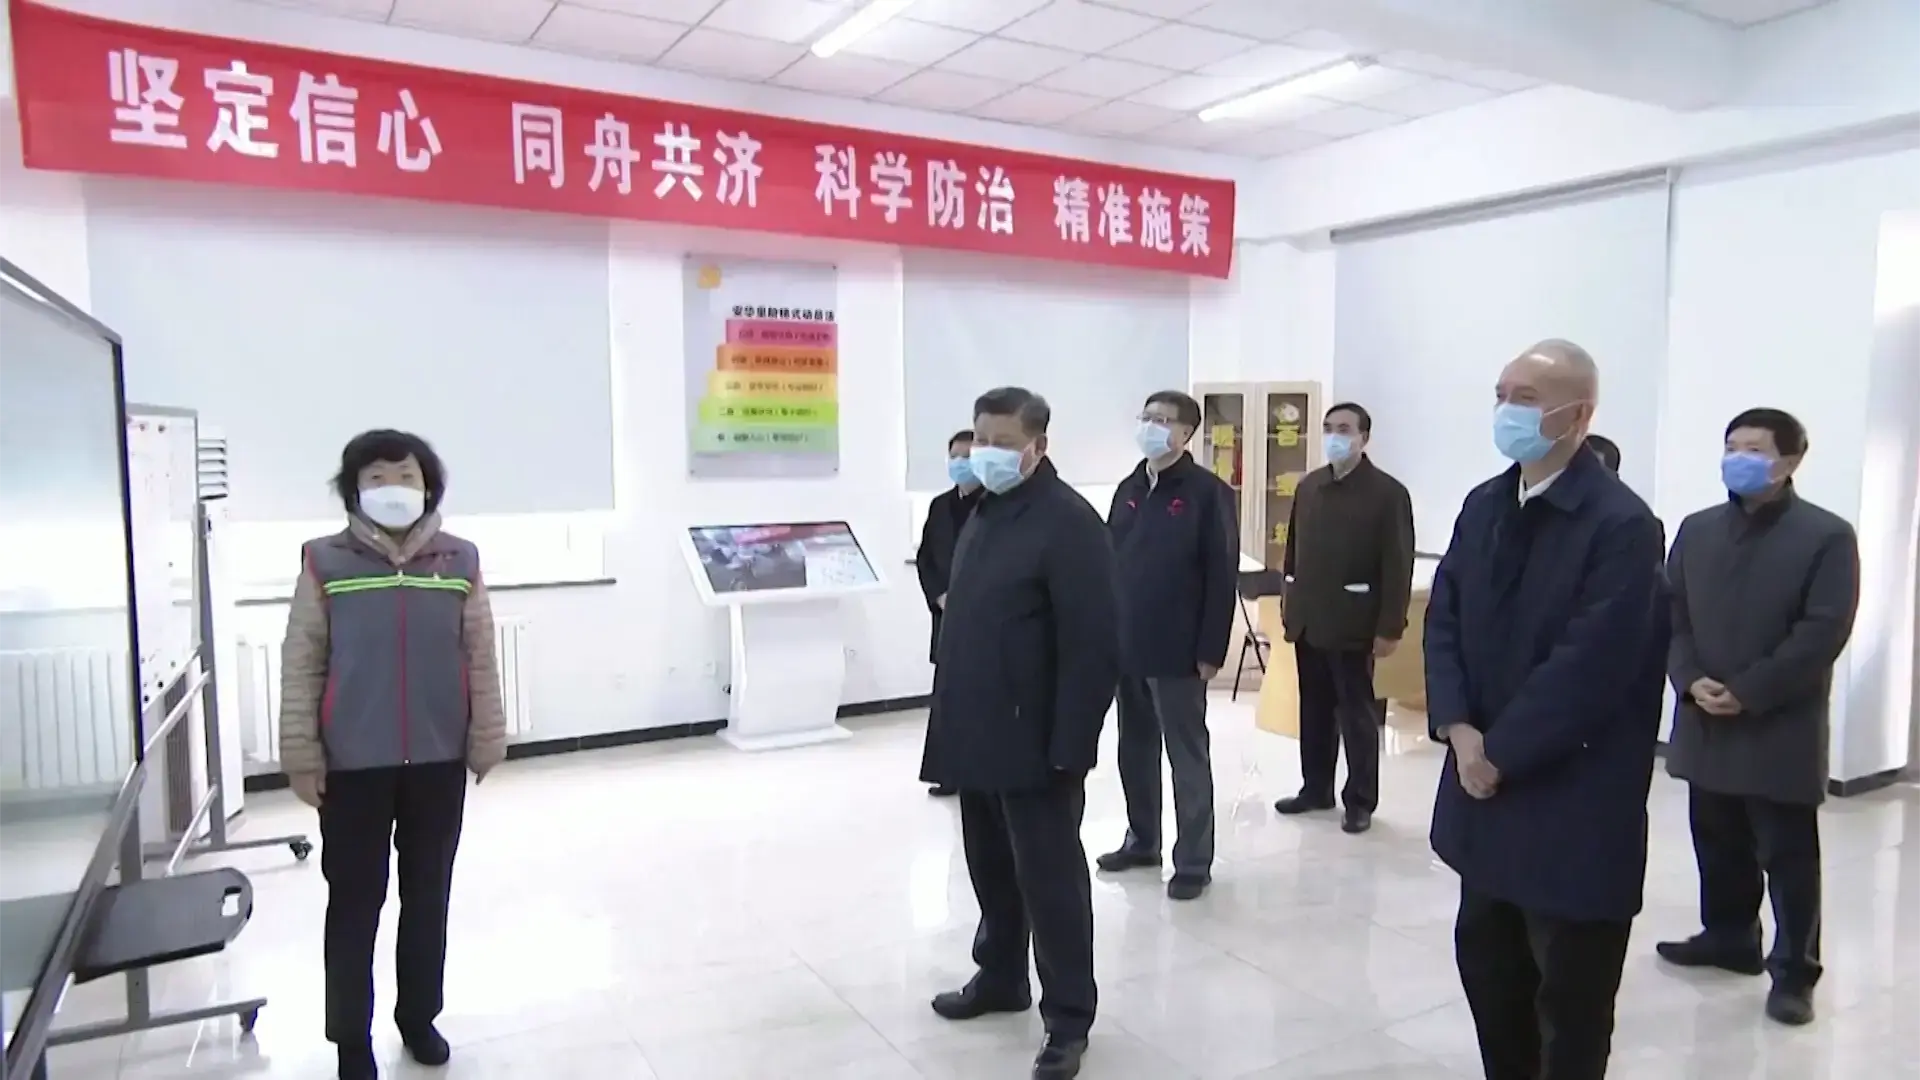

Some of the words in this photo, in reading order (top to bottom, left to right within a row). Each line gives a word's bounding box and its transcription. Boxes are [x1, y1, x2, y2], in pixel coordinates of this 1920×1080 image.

[108, 48, 443, 173] 坚定信心
[511, 101, 764, 209] 同舟共济
[814, 144, 1016, 235] 科学防治
[1053, 175, 1212, 258] 精准施策
